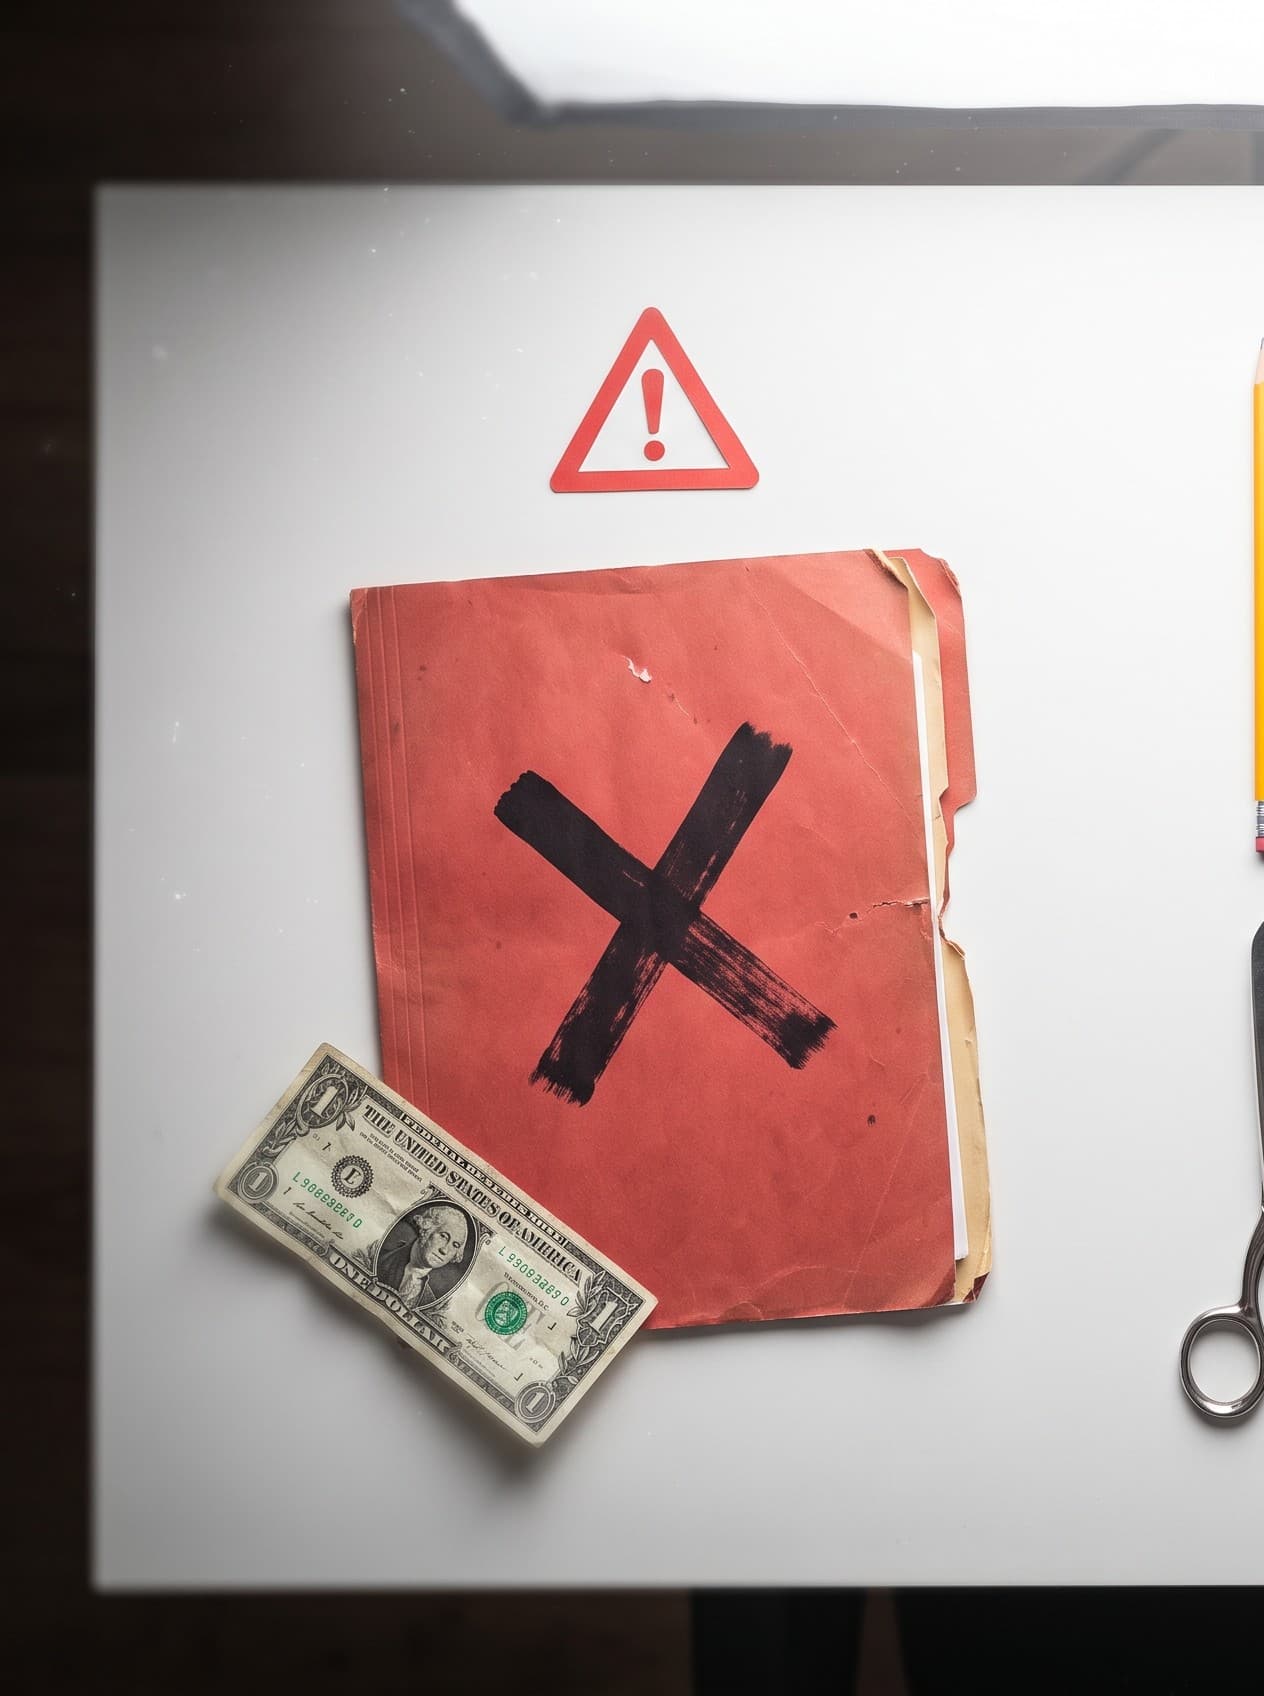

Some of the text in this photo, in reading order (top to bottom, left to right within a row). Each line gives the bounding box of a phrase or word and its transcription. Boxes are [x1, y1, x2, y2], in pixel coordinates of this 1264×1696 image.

[310, 1085, 337, 1116] 1
[248, 1171, 267, 1191] 1
[394, 1129, 447, 1175] UNITED
[446, 1170, 499, 1216] STATES
[329, 1252, 371, 1289] ONE
[586, 1297, 619, 1333] 1
[525, 1390, 543, 1412] 1
